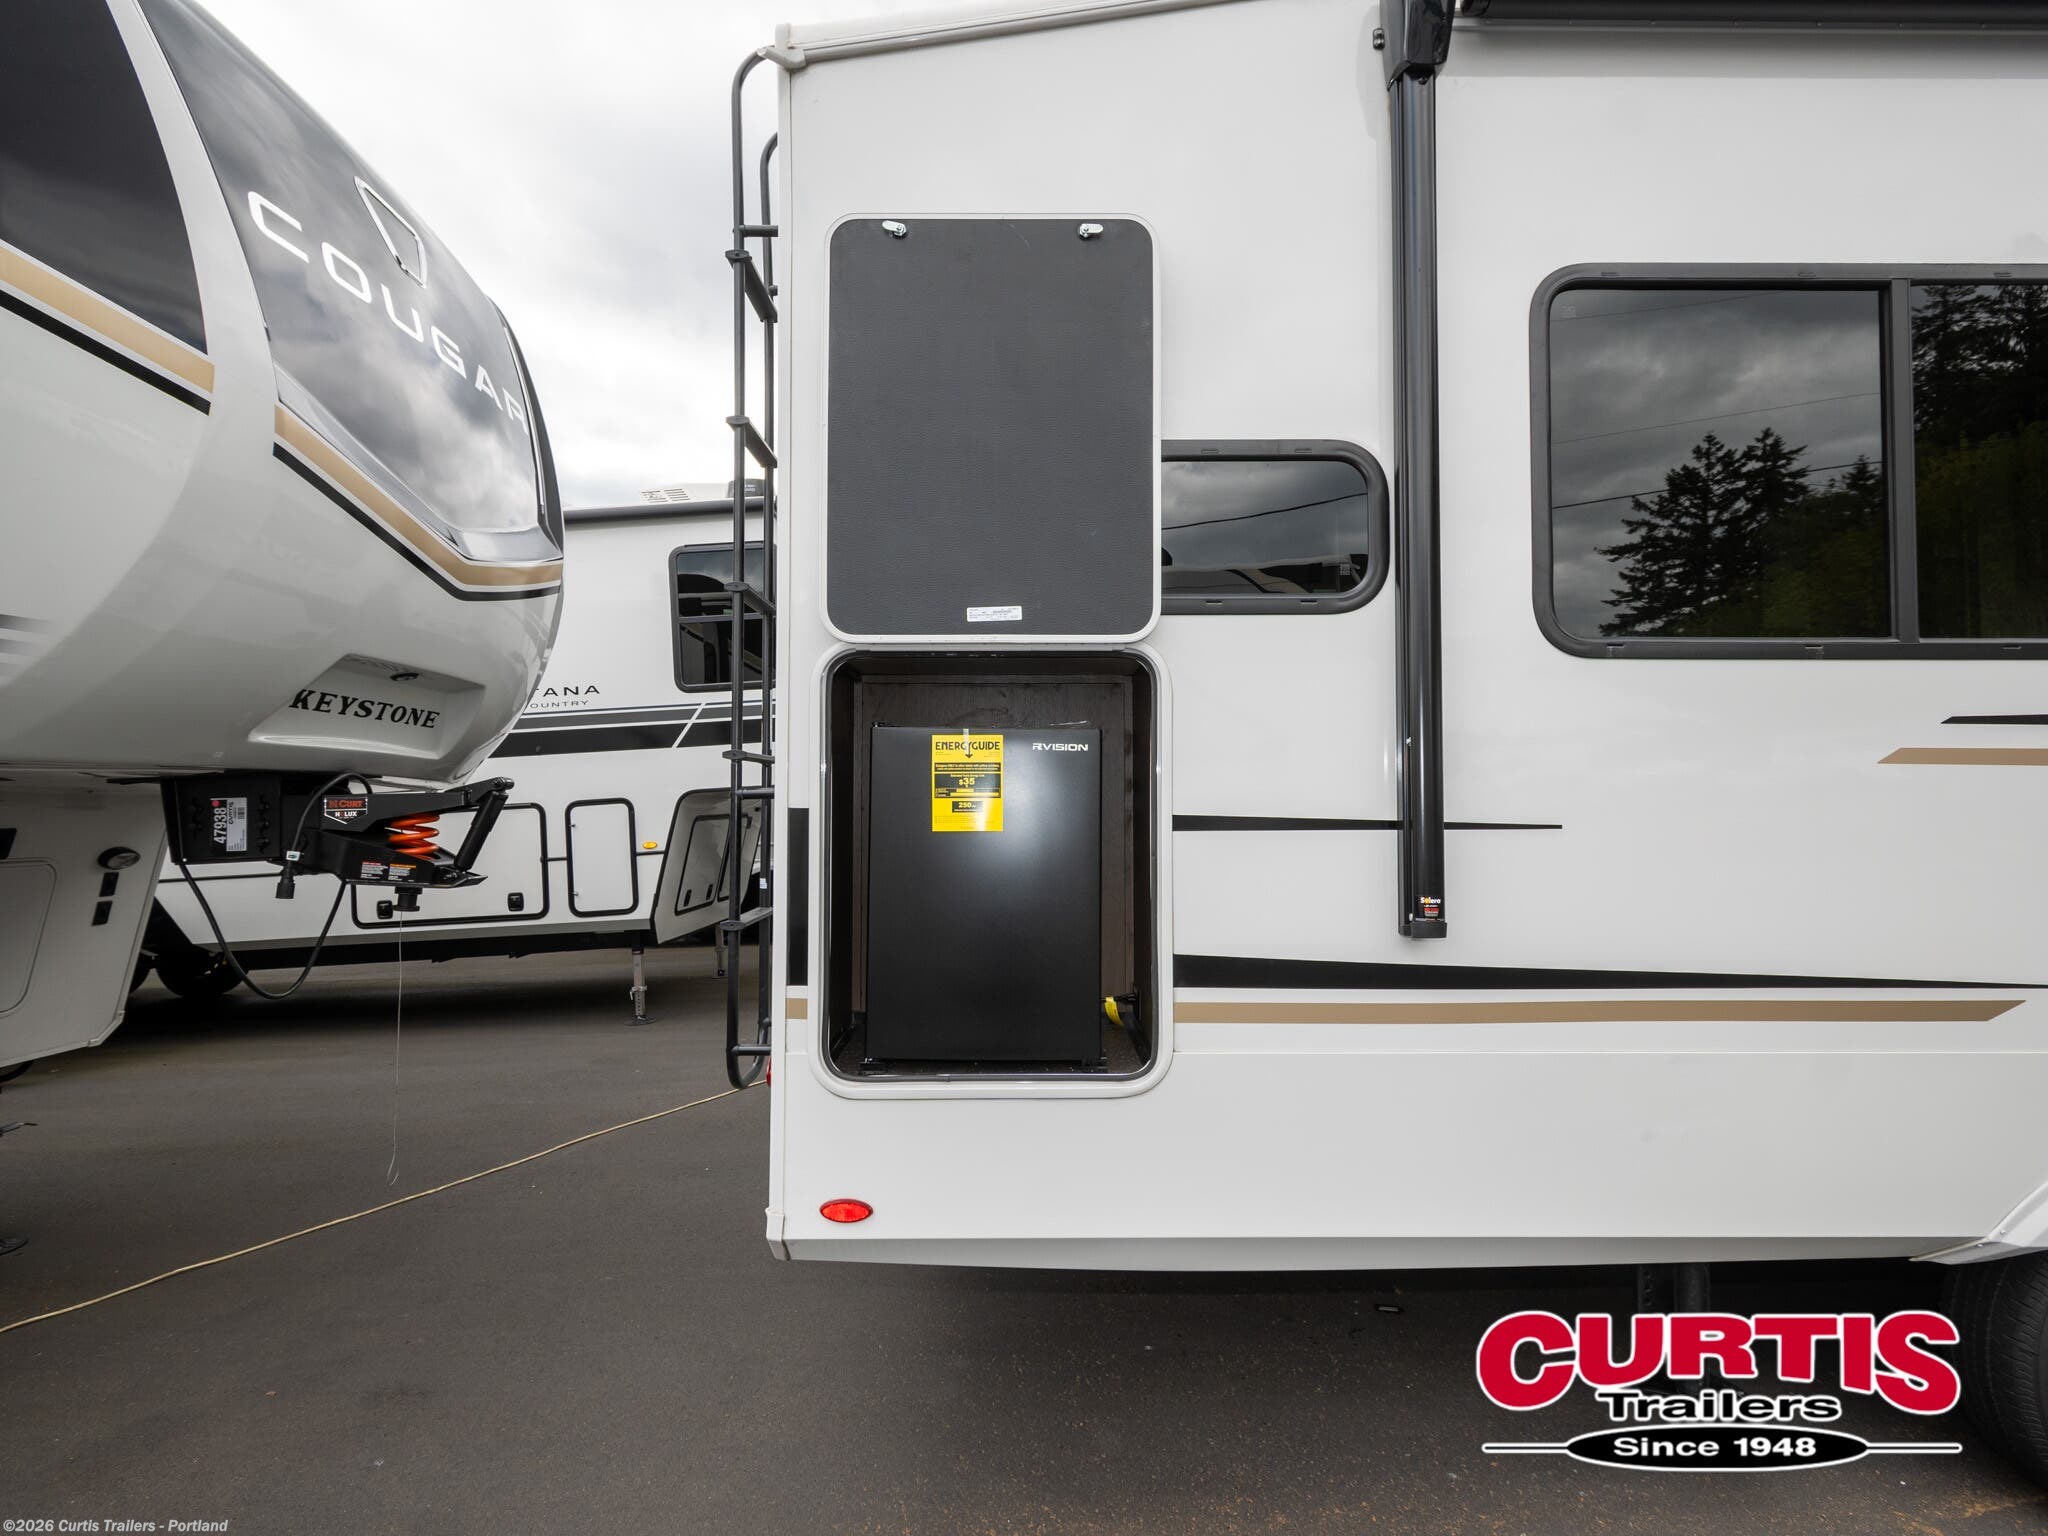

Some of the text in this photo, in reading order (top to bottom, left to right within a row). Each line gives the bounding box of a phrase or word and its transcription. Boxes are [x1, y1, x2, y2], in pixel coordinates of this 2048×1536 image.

[248, 191, 529, 436] COUGAR
[536, 685, 600, 697] ANA
[289, 688, 440, 728] KEYSTONE
[530, 700, 589, 709] OUNTRY
[1032, 742, 1089, 752] RVISION
[213, 808, 227, 844] 47938
